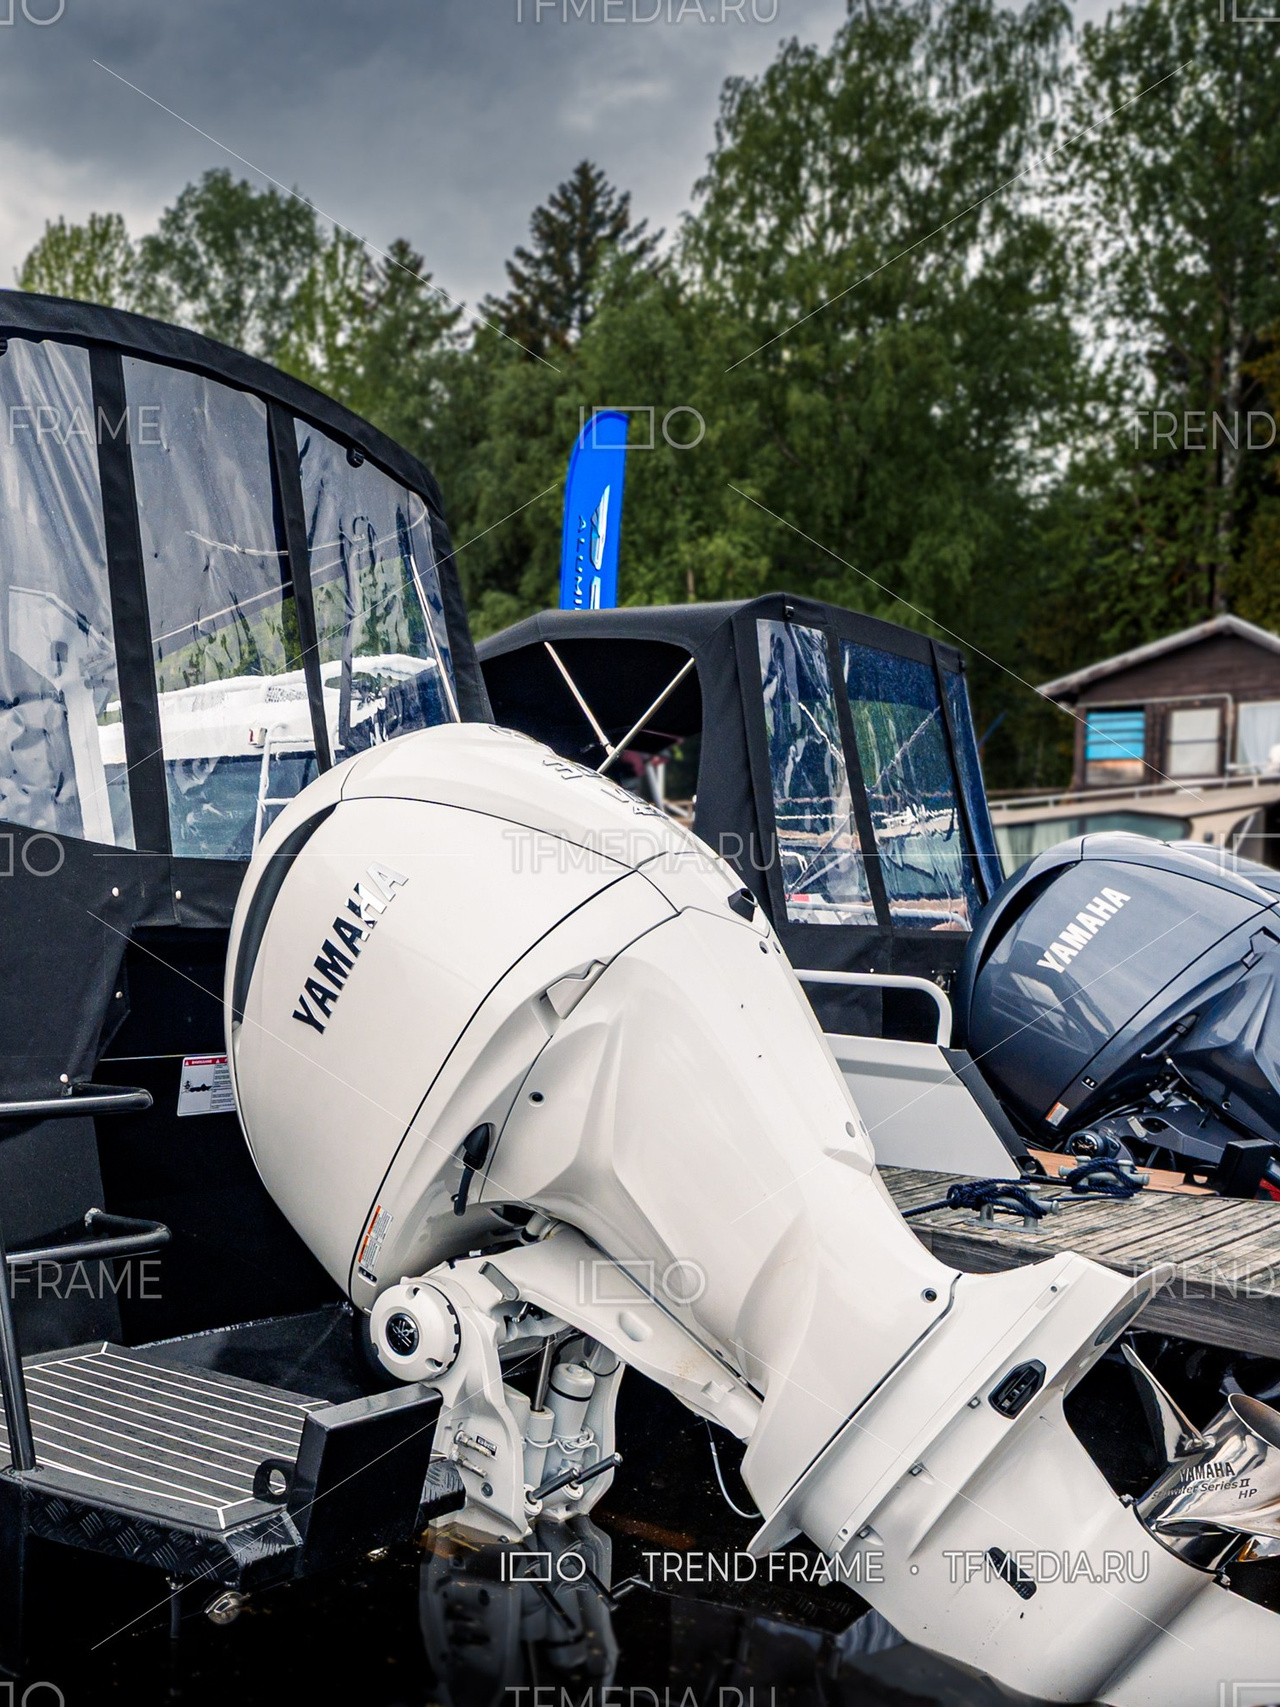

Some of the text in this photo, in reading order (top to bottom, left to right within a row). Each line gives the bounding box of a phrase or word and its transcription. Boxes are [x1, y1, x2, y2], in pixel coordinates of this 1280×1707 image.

[574, 515, 586, 610] ALUMI
[292, 861, 410, 1035] YAMAHA
[1036, 887, 1132, 974] YAMAHA
[1179, 1461, 1235, 1482] YAMAHA
[1200, 1480, 1238, 1492] Series
[1238, 1488, 1258, 1500] HP
